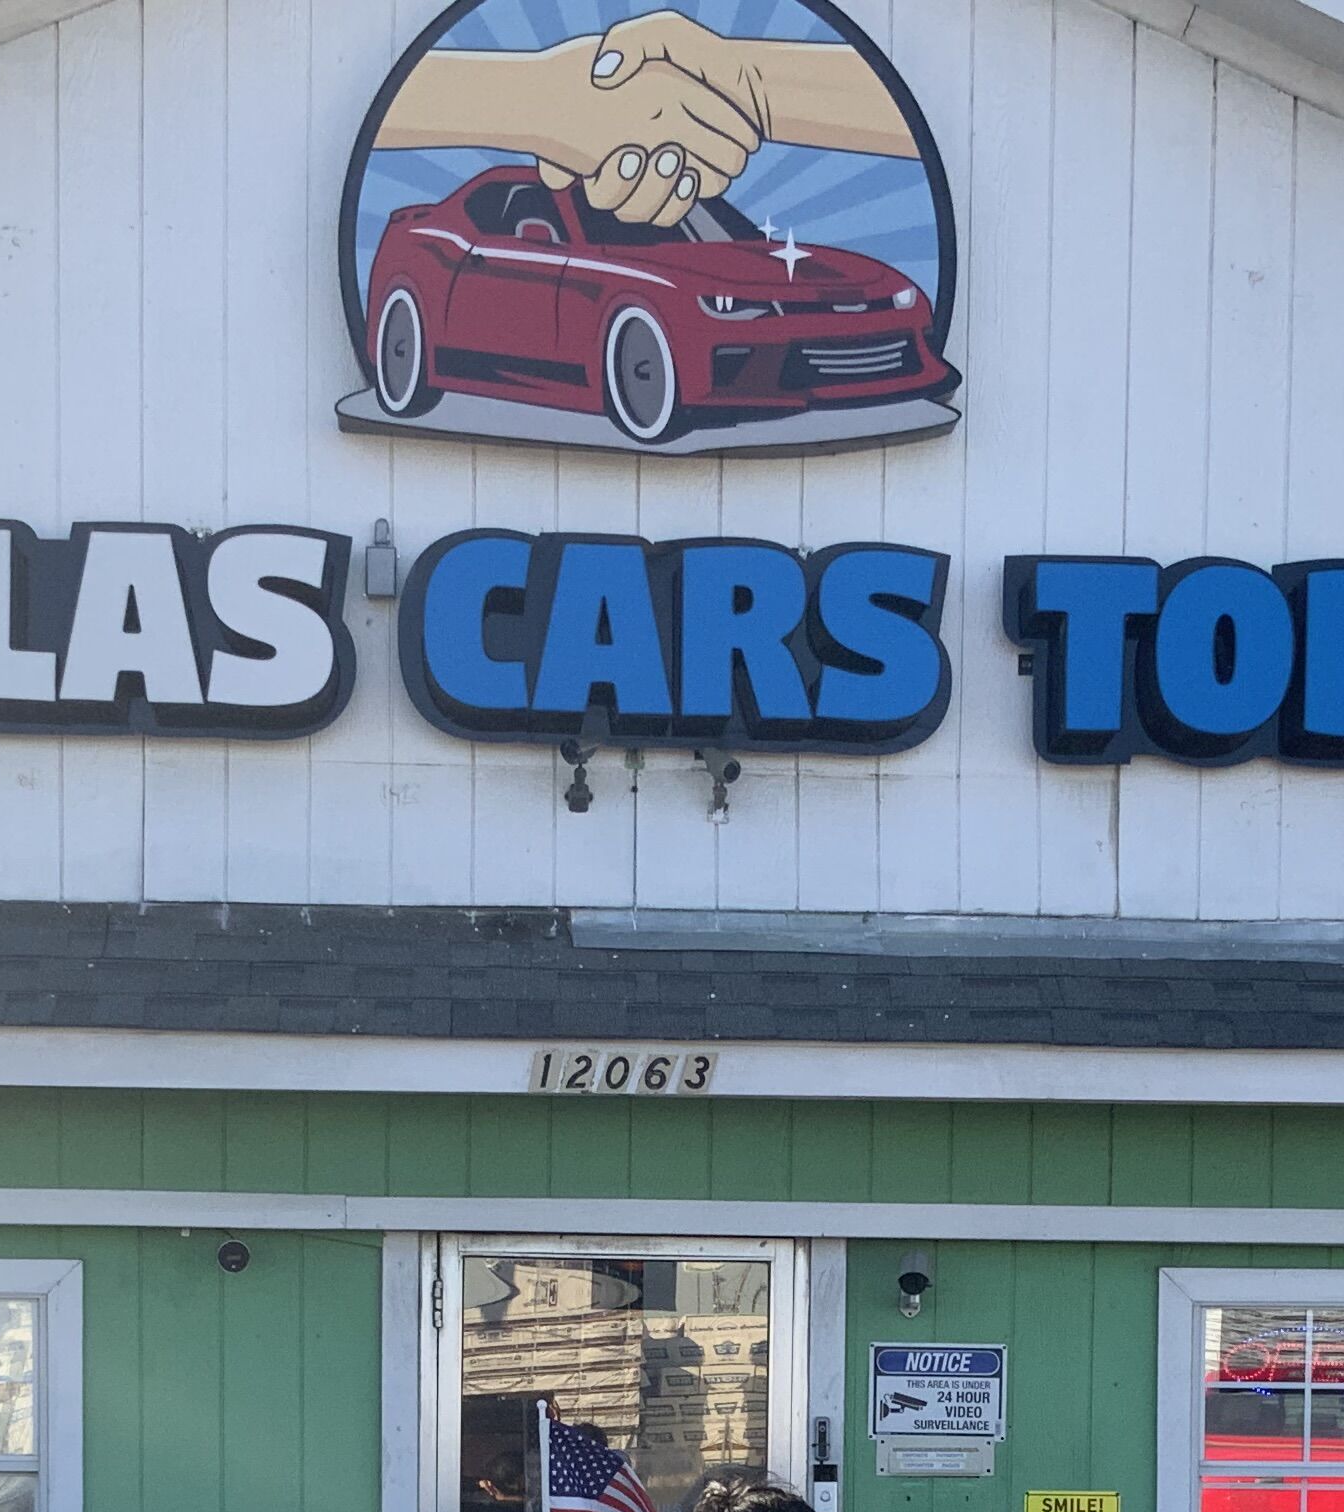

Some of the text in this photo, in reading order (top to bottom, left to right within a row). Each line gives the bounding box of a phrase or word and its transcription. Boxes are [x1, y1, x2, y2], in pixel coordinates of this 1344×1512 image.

[422, 537, 943, 722] CARS
[540, 1053, 711, 1091] 12063
[905, 1352, 973, 1373] NOTICE
[906, 1380, 991, 1390] THIS AREA IS UNDER
[937, 1391, 991, 1404] 24 HOUR
[945, 1406, 982, 1418] VIDEO
[913, 1420, 990, 1431] SURVEILLANCE
[1041, 1497, 1104, 1512] SMILE!
